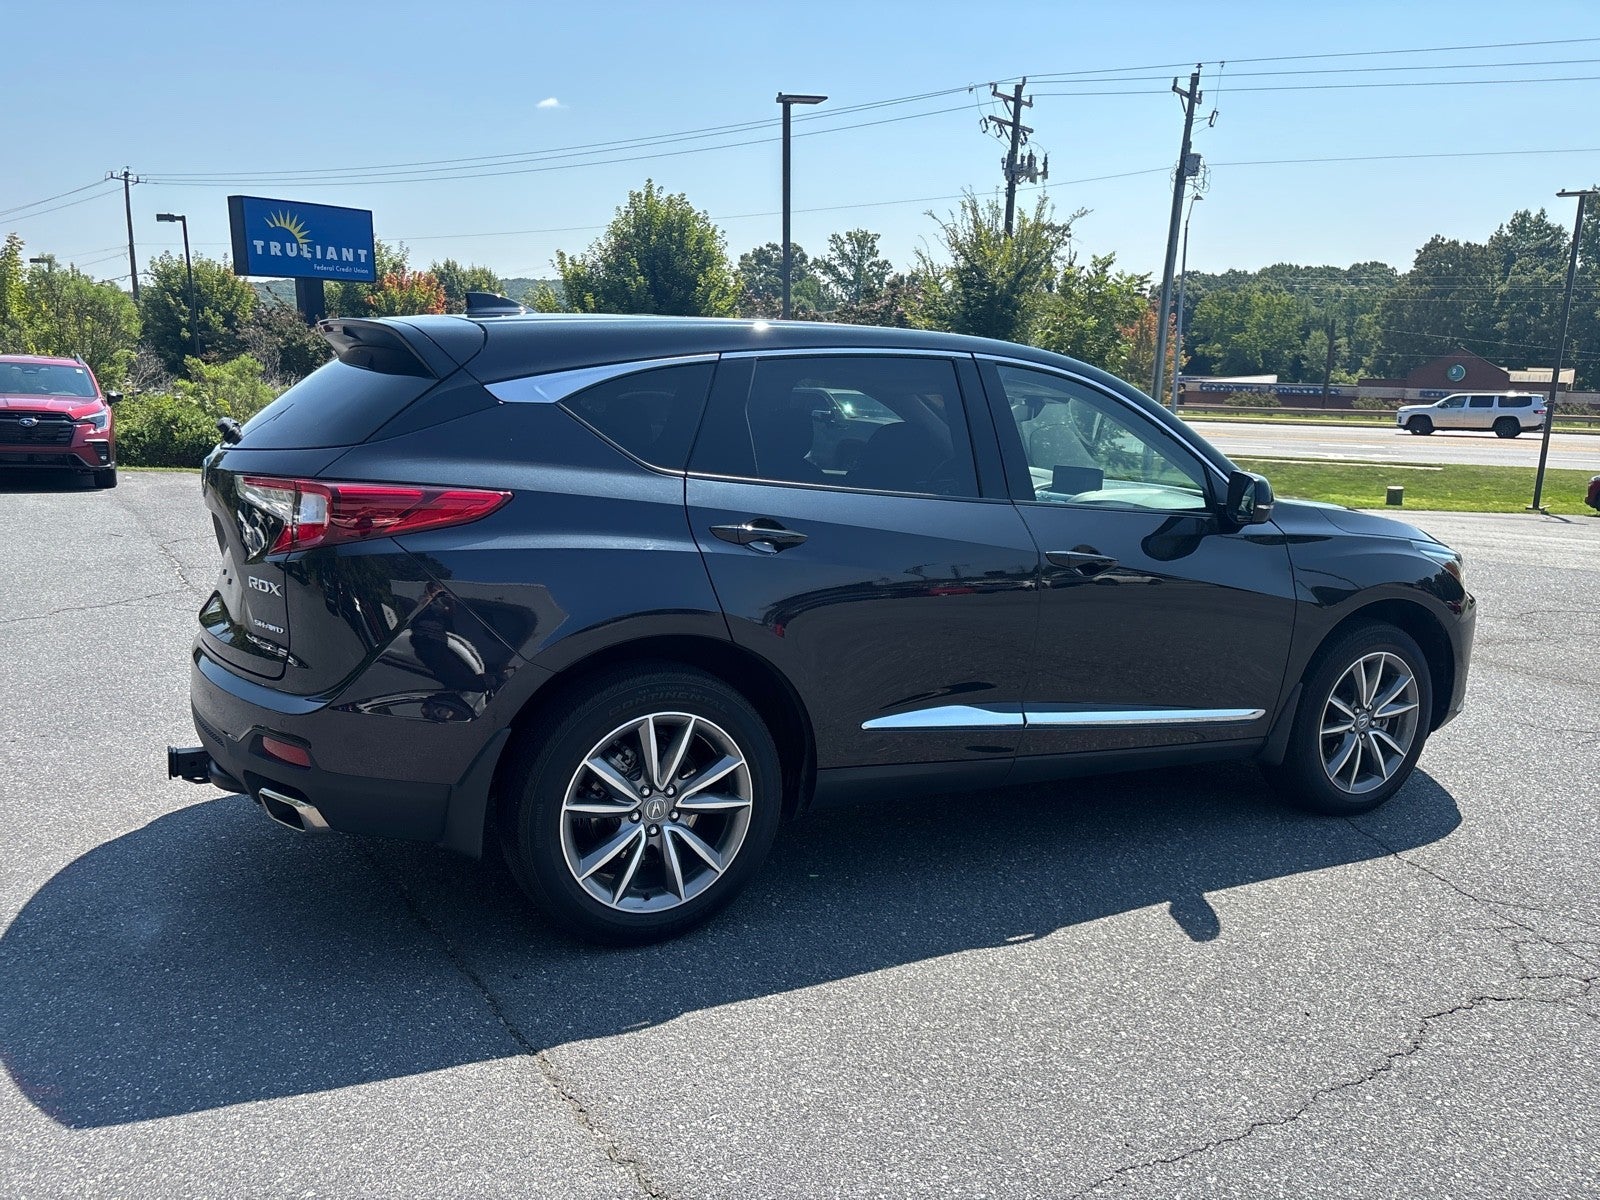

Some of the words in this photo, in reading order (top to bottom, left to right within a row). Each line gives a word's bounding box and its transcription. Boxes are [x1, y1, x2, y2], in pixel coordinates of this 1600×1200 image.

[252, 239, 368, 263] TRULIANT
[313, 263, 335, 272] Federal
[335, 265, 352, 273] Credit
[248, 575, 283, 598] RDX
